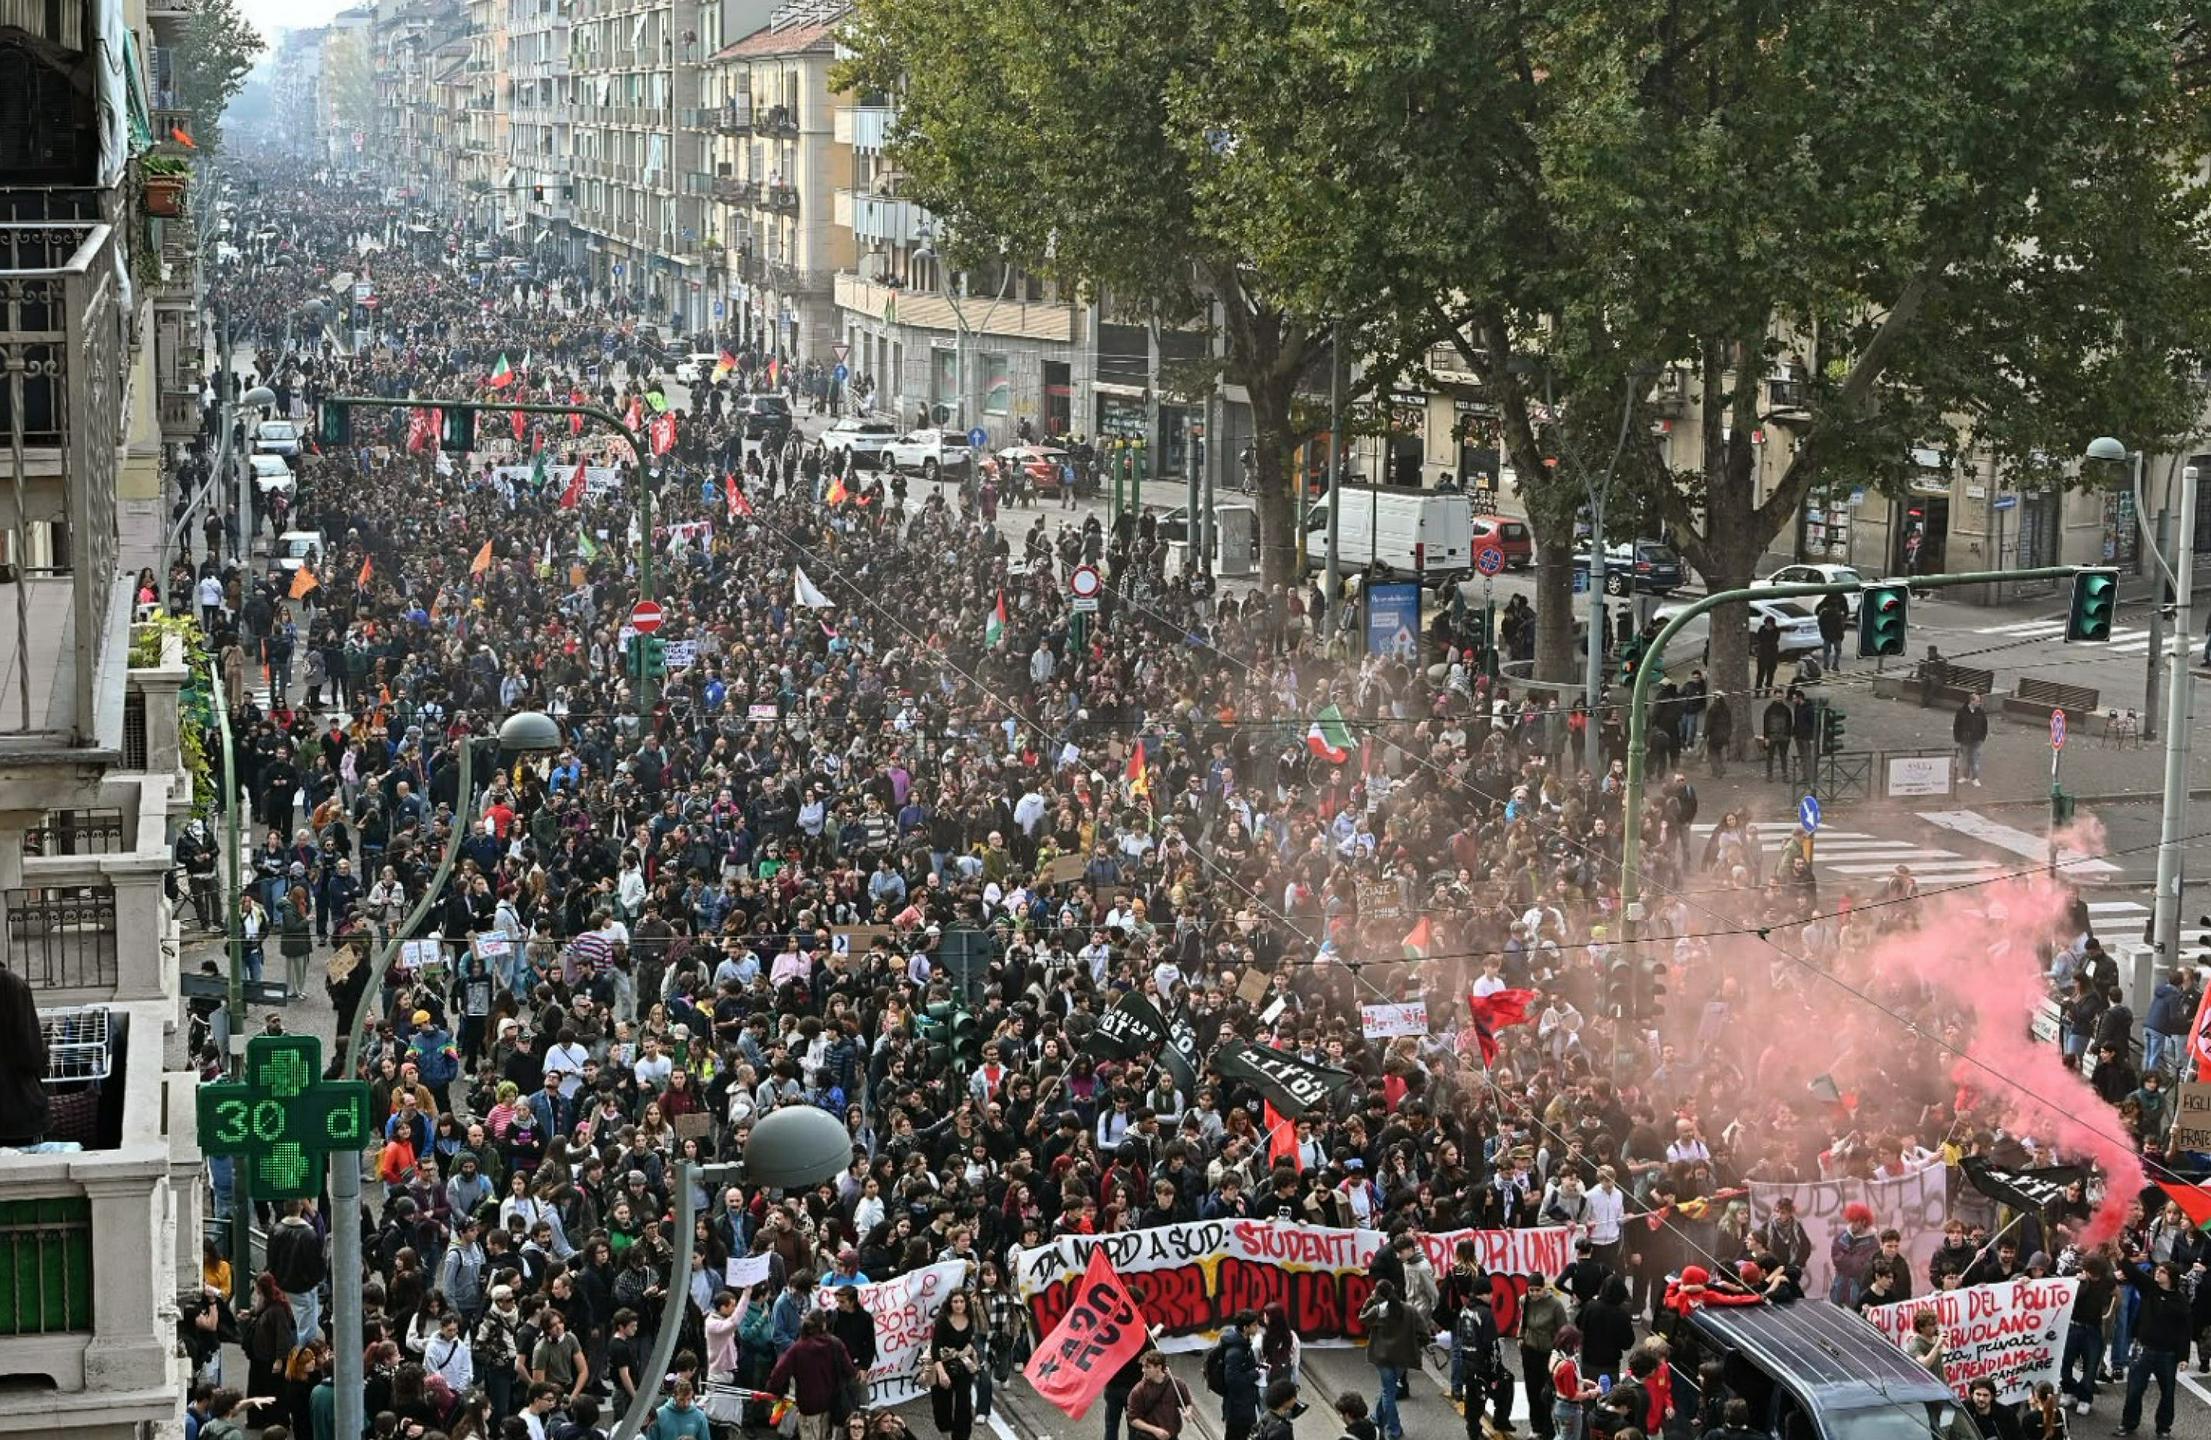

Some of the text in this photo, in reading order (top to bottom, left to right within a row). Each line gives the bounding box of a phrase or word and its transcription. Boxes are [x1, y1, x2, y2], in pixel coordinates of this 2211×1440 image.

[216, 1100, 285, 1143] 30
[1030, 1248, 1068, 1284] DA
[1148, 1228, 1169, 1262] A
[1233, 1221, 1357, 1267] STUDENTI
[1969, 1289, 2001, 1322] DEL
